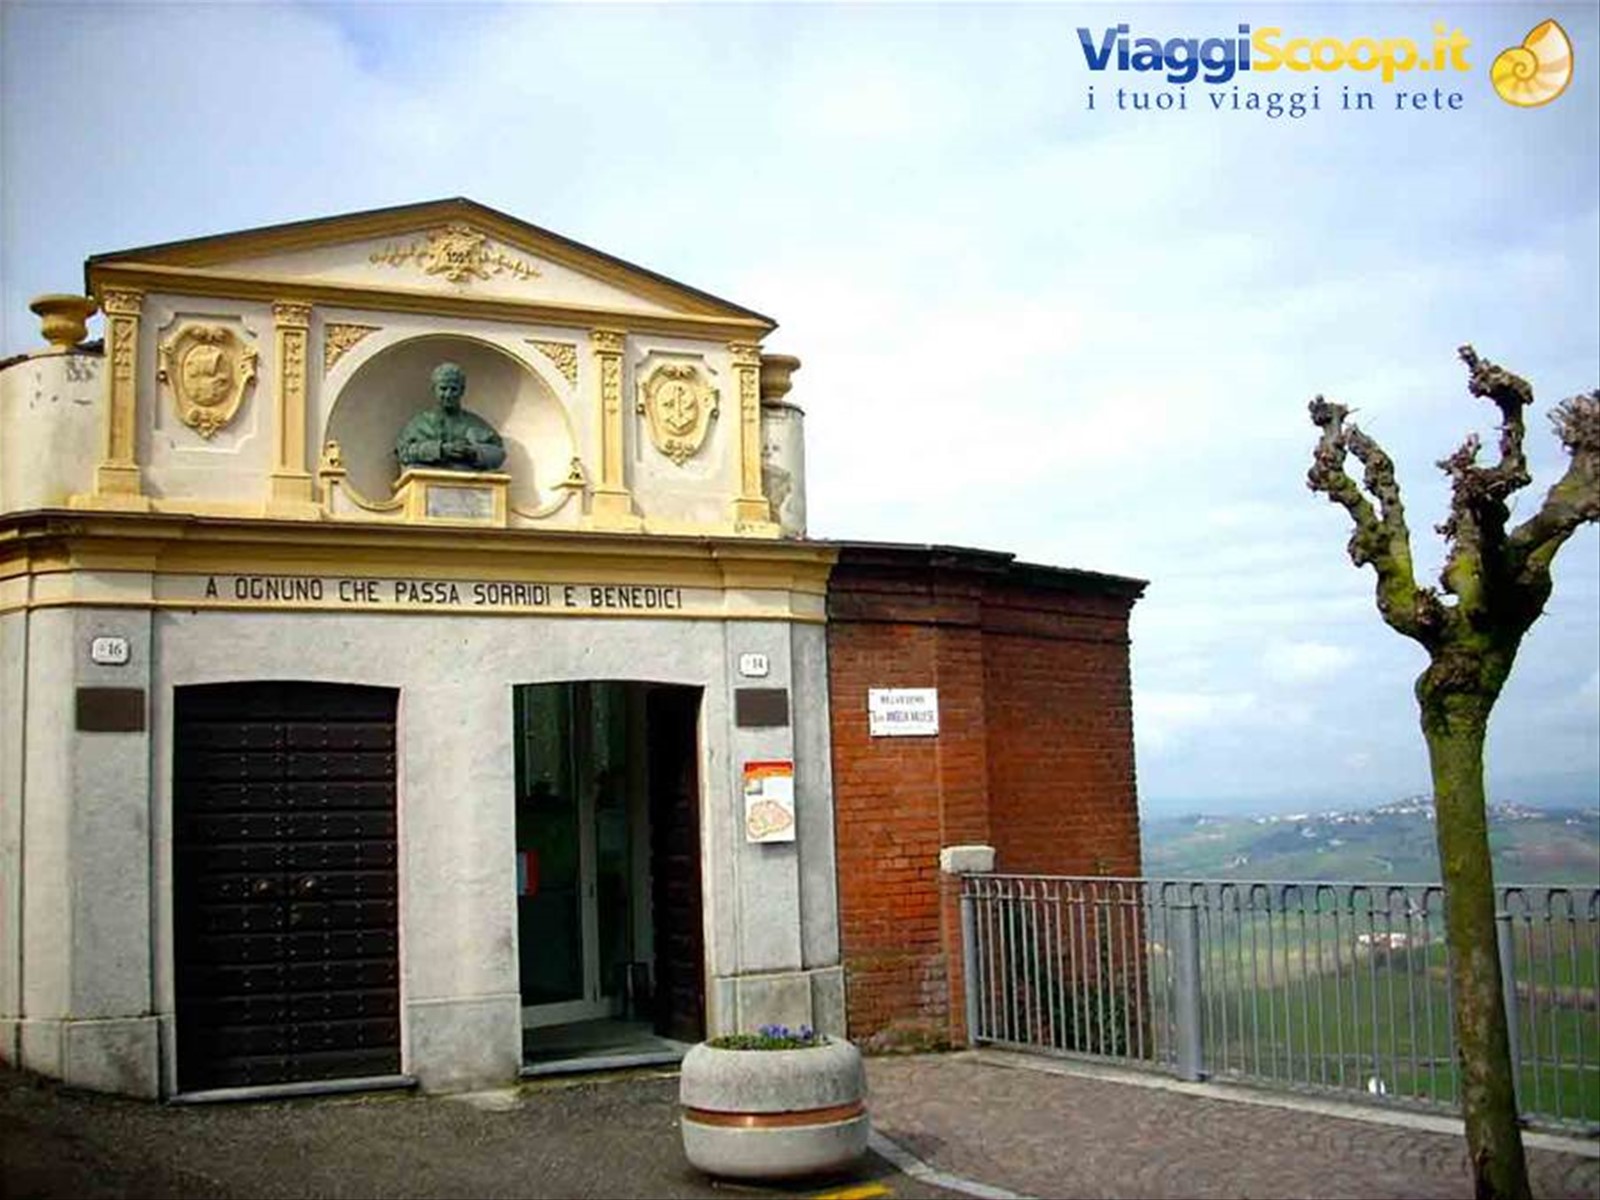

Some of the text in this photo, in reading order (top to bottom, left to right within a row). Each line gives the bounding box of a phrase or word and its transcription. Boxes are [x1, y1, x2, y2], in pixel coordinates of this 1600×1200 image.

[205, 577, 682, 609] A OGNUNO CHE PASSA SORRIDI E BENEDICI
